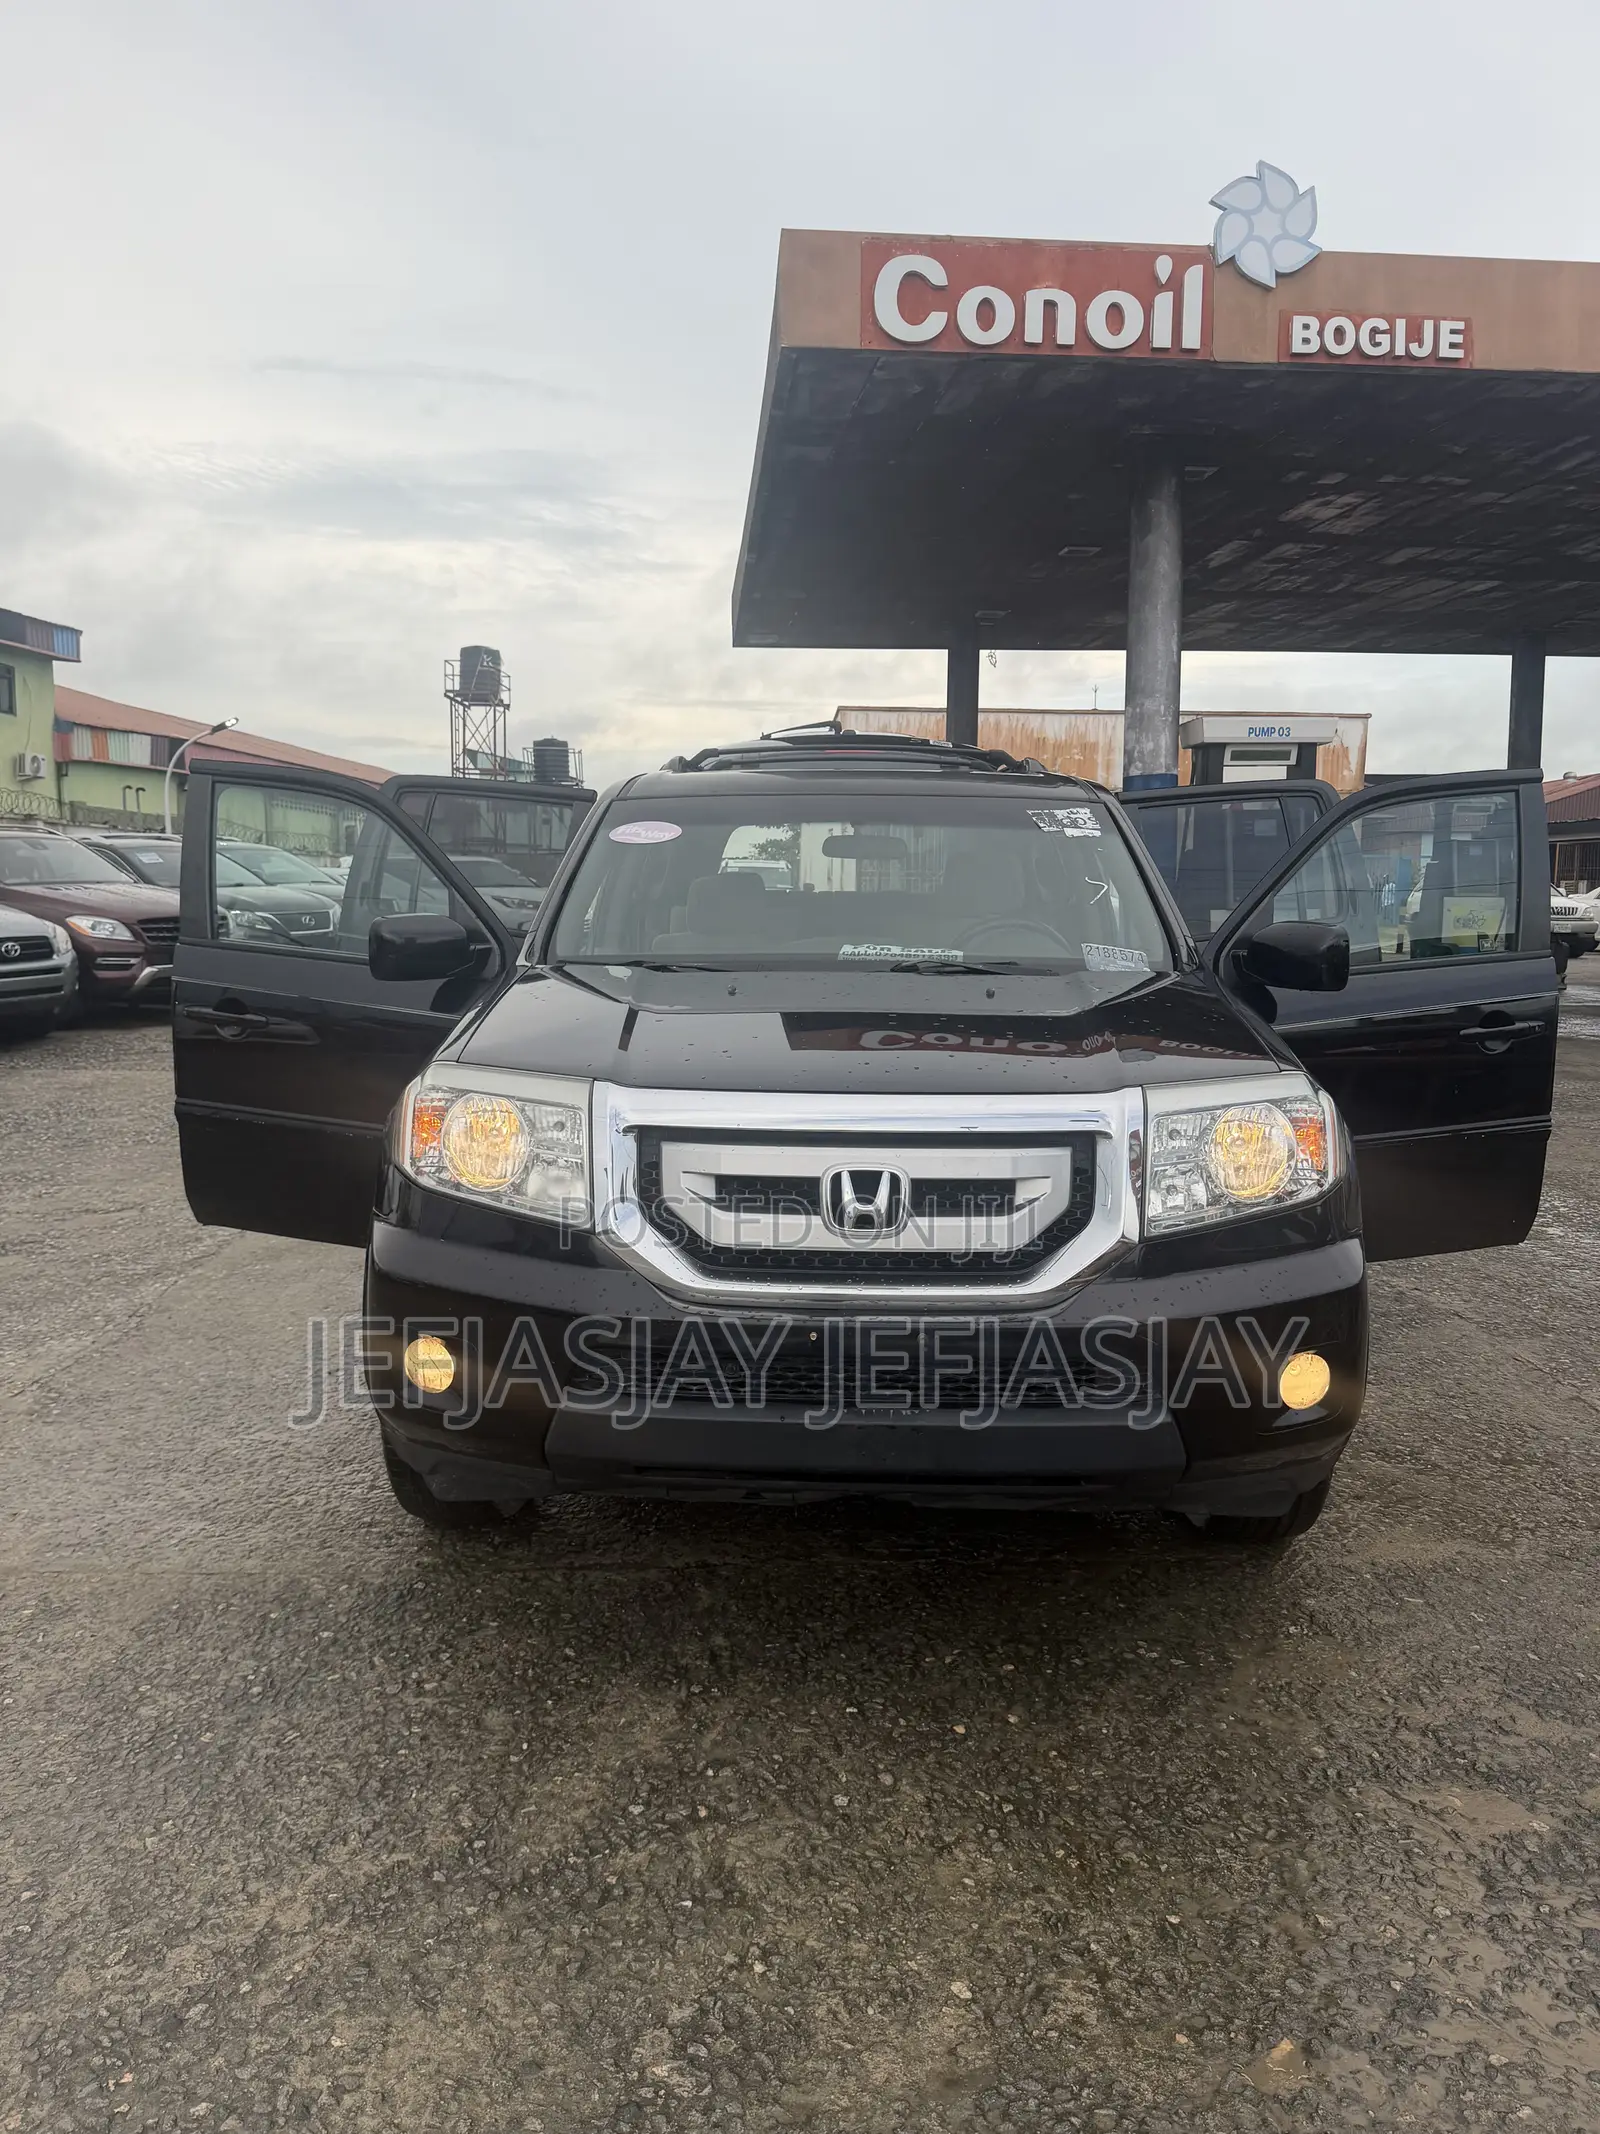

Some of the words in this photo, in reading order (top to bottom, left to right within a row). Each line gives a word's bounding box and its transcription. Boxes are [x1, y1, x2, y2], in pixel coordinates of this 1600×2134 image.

[874, 254, 1204, 350] Conoil
[1290, 315, 1466, 359] BOGIJE
[1247, 726, 1276, 738] PUMP
[1277, 726, 1291, 738] 03
